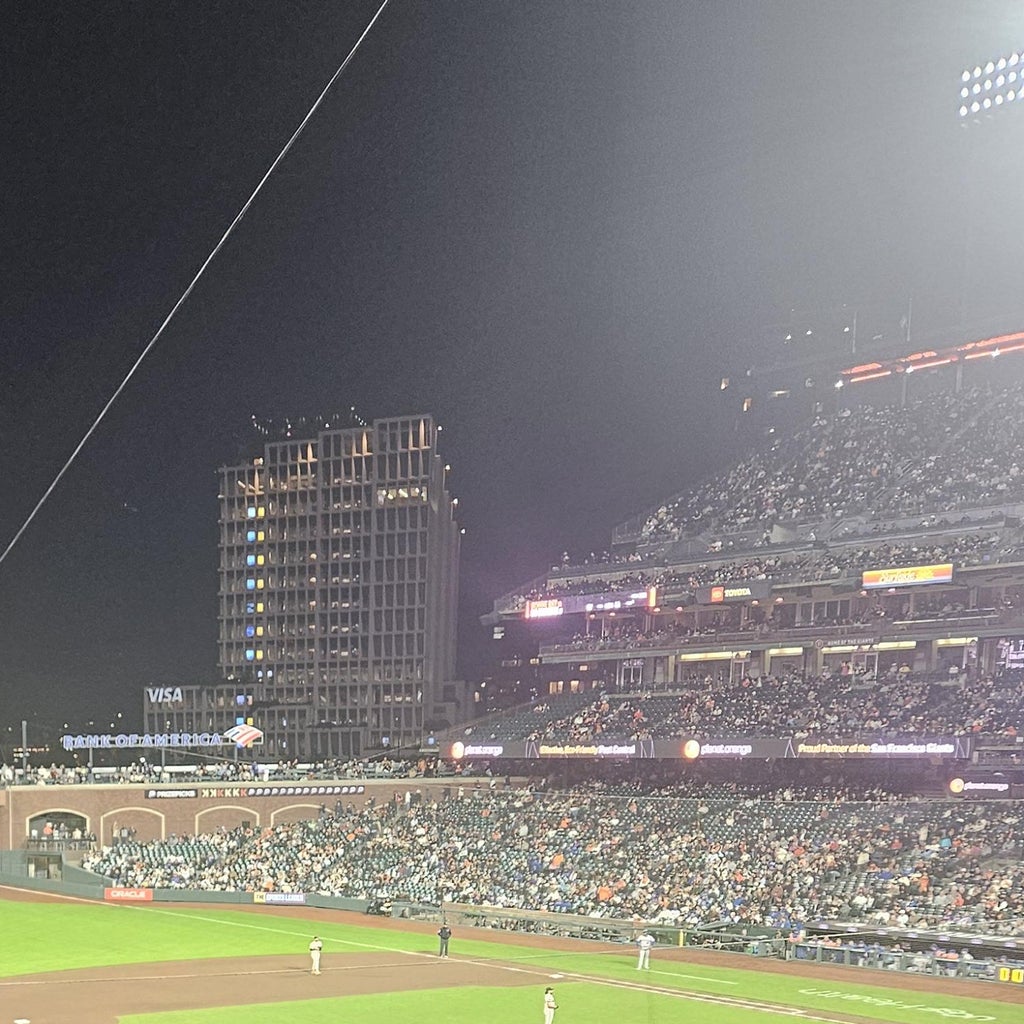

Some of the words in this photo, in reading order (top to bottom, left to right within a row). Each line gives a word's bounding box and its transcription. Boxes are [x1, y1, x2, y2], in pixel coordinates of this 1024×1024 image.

[725, 588, 751, 597] TOYOTA
[147, 687, 183, 703] VISA
[63, 734, 111, 748] BANK
[115, 733, 137, 747] OF
[140, 732, 224, 747] AMERICA
[798, 743, 820, 754] Proud
[821, 743, 849, 754] Partner
[926, 743, 954, 753] Giants
[111, 890, 146, 899] ORACLE
